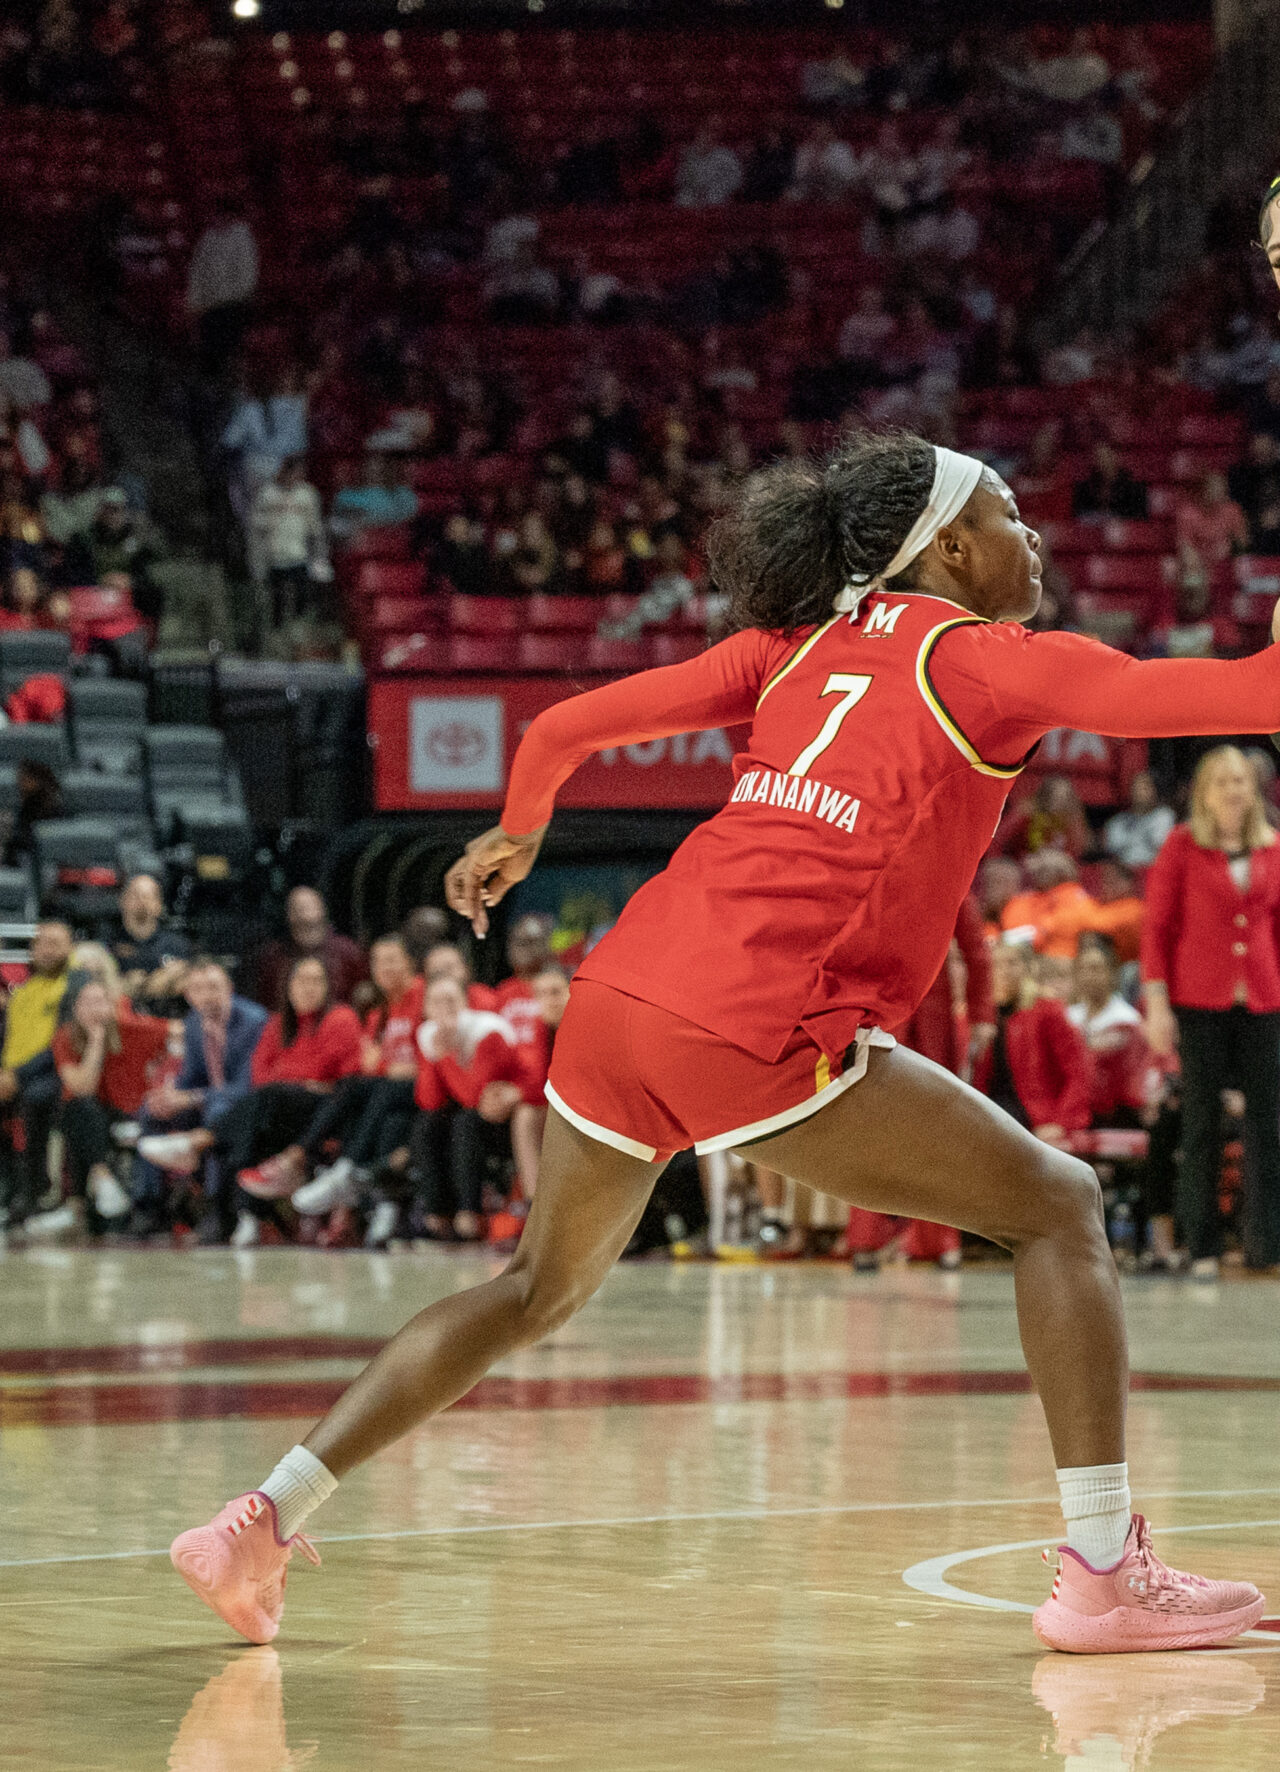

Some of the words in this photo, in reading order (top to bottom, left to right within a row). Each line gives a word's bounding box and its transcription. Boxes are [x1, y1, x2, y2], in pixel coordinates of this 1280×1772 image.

[862, 602, 910, 633] M
[788, 672, 875, 778] 7
[731, 769, 861, 834] OKANANWA
